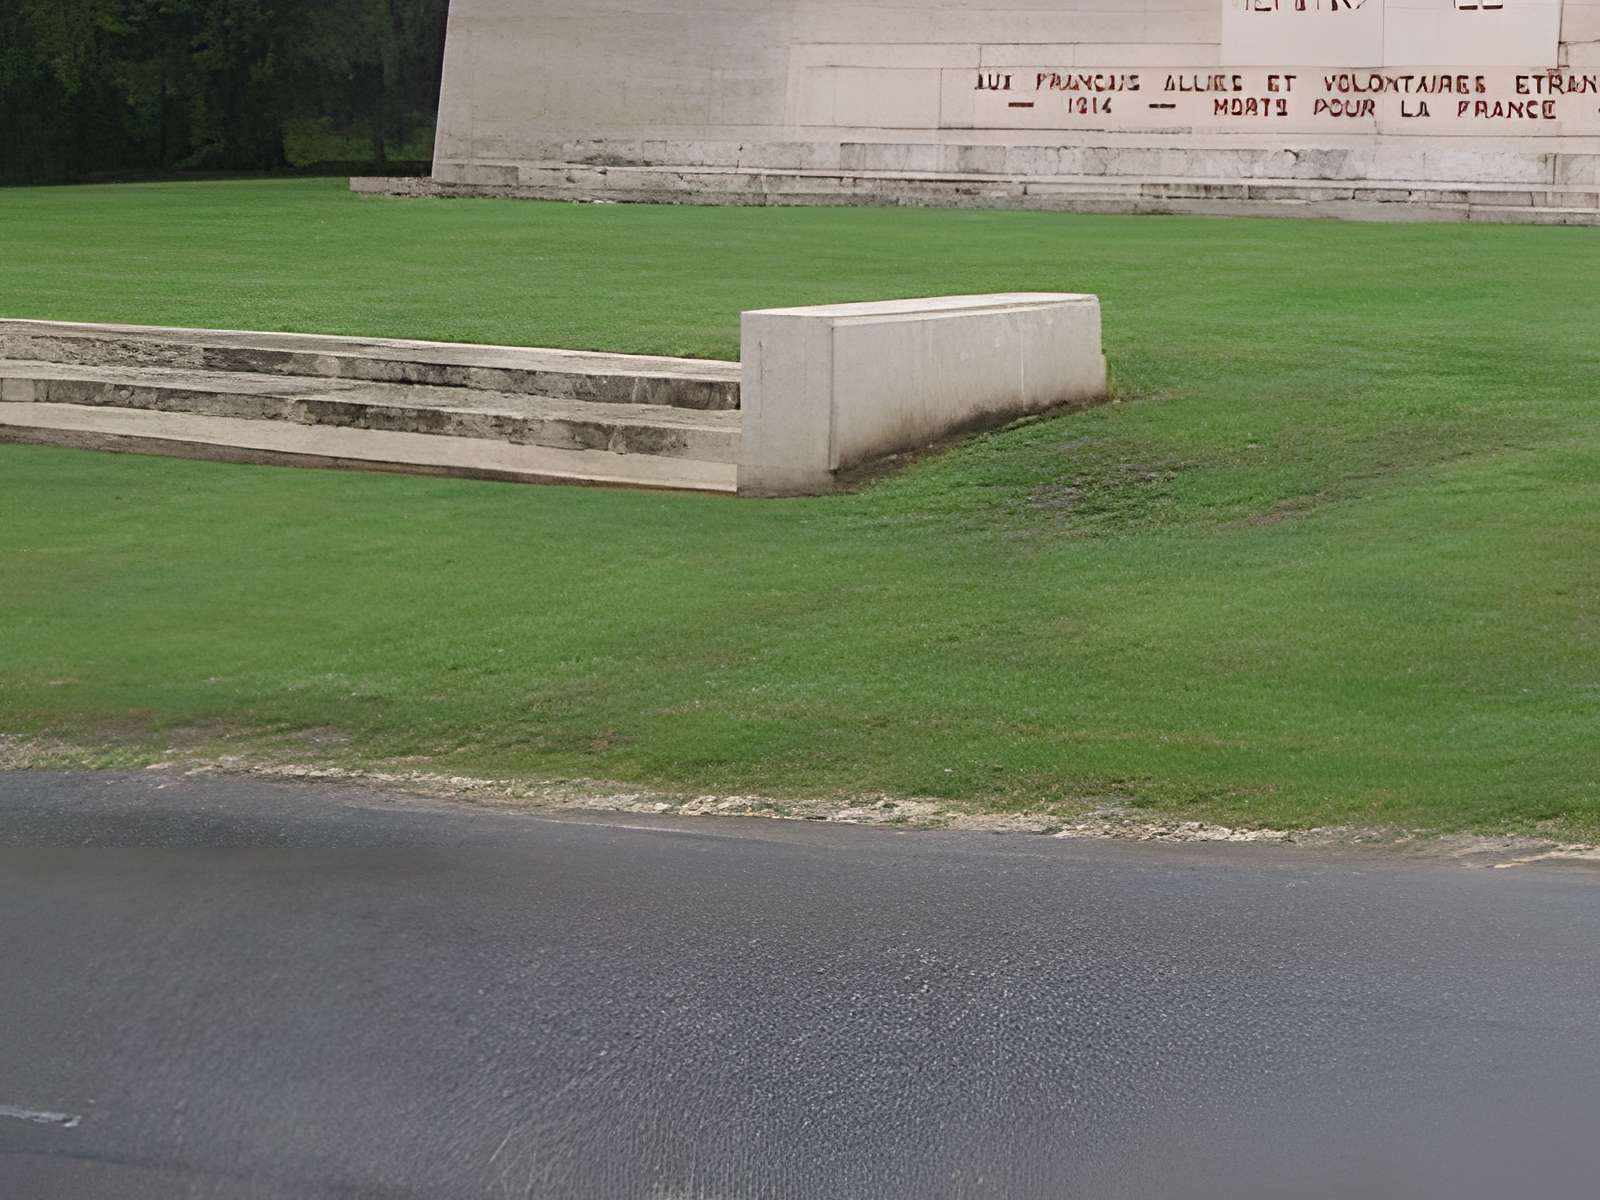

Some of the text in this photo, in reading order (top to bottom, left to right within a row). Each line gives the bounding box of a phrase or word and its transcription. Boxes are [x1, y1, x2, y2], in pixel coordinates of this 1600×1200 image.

[1268, 74, 1297, 92] ET
[1313, 98, 1375, 118] POUR
[1401, 100, 1431, 118] LA
